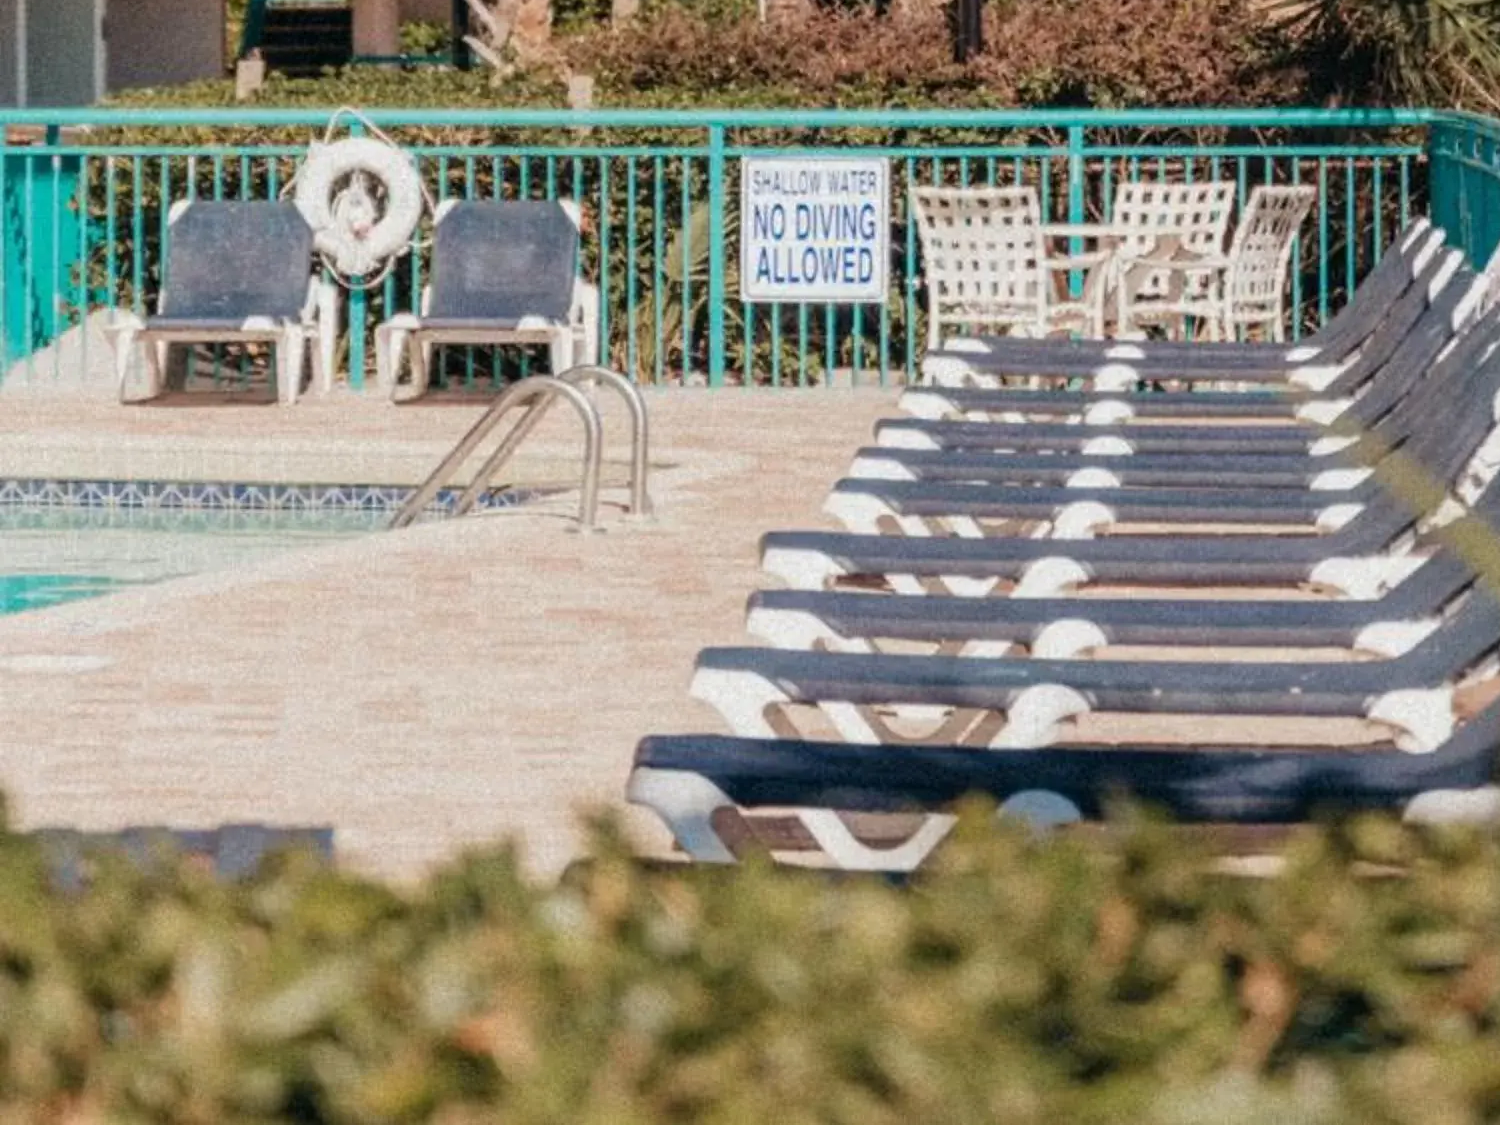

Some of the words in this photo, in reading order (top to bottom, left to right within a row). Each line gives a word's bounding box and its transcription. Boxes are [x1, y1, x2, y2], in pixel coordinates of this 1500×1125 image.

[754, 171, 820, 194] SHALLOW
[828, 171, 877, 194] WATER
[754, 204, 785, 240] NO
[796, 204, 875, 240] DIVING
[756, 246, 873, 284] ALLOWED
